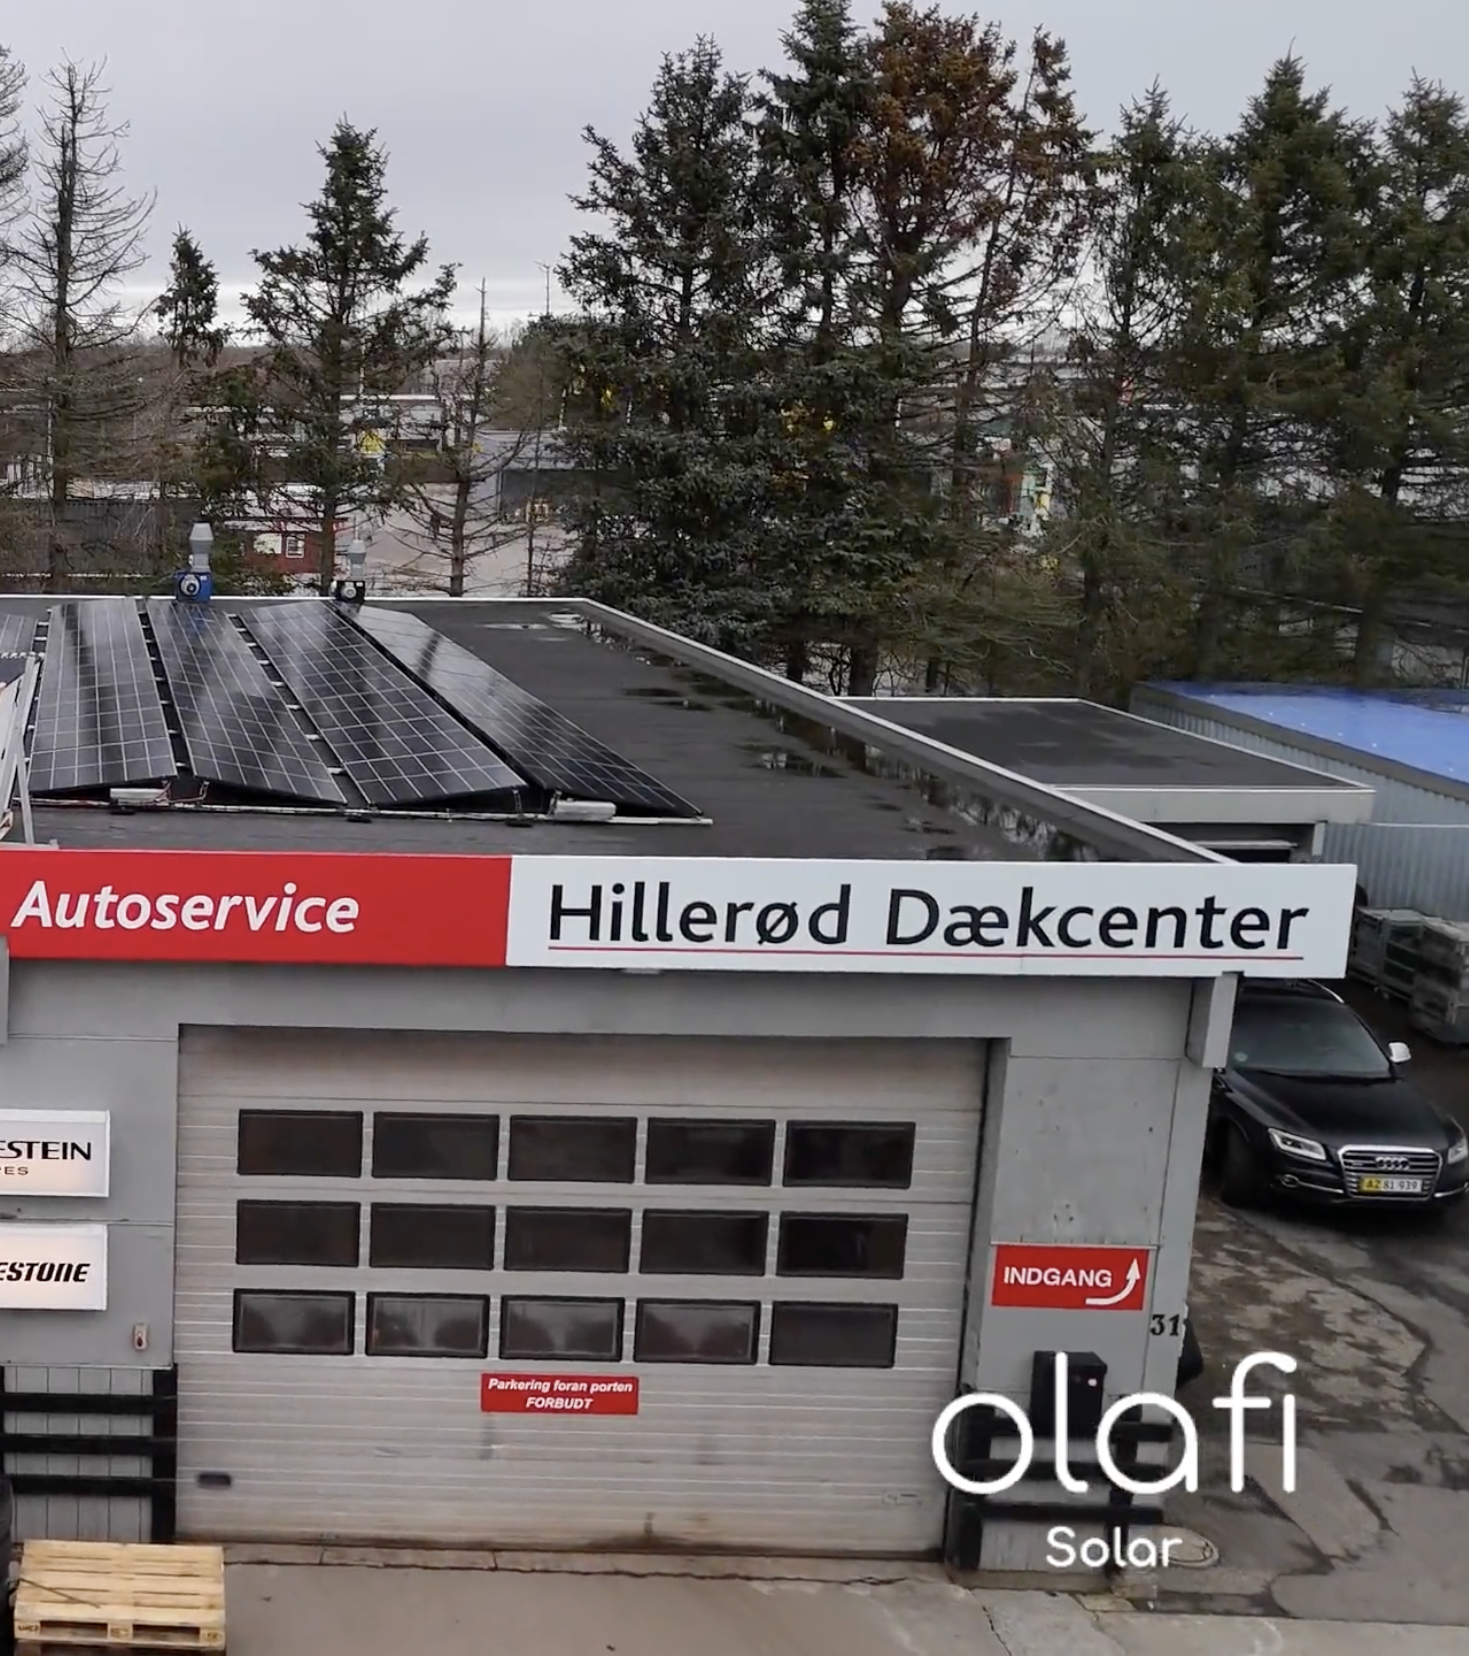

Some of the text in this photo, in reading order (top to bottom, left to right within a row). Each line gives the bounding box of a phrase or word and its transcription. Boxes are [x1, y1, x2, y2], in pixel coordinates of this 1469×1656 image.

[10, 880, 359, 933] Autoservice
[548, 881, 1310, 950] Hillerød Dækcenter
[1003, 1266, 1112, 1288] INDGANG
[1149, 1314, 1180, 1337] 31
[488, 1378, 633, 1394] Parkering foran porten
[525, 1396, 594, 1409] FORBUDT
